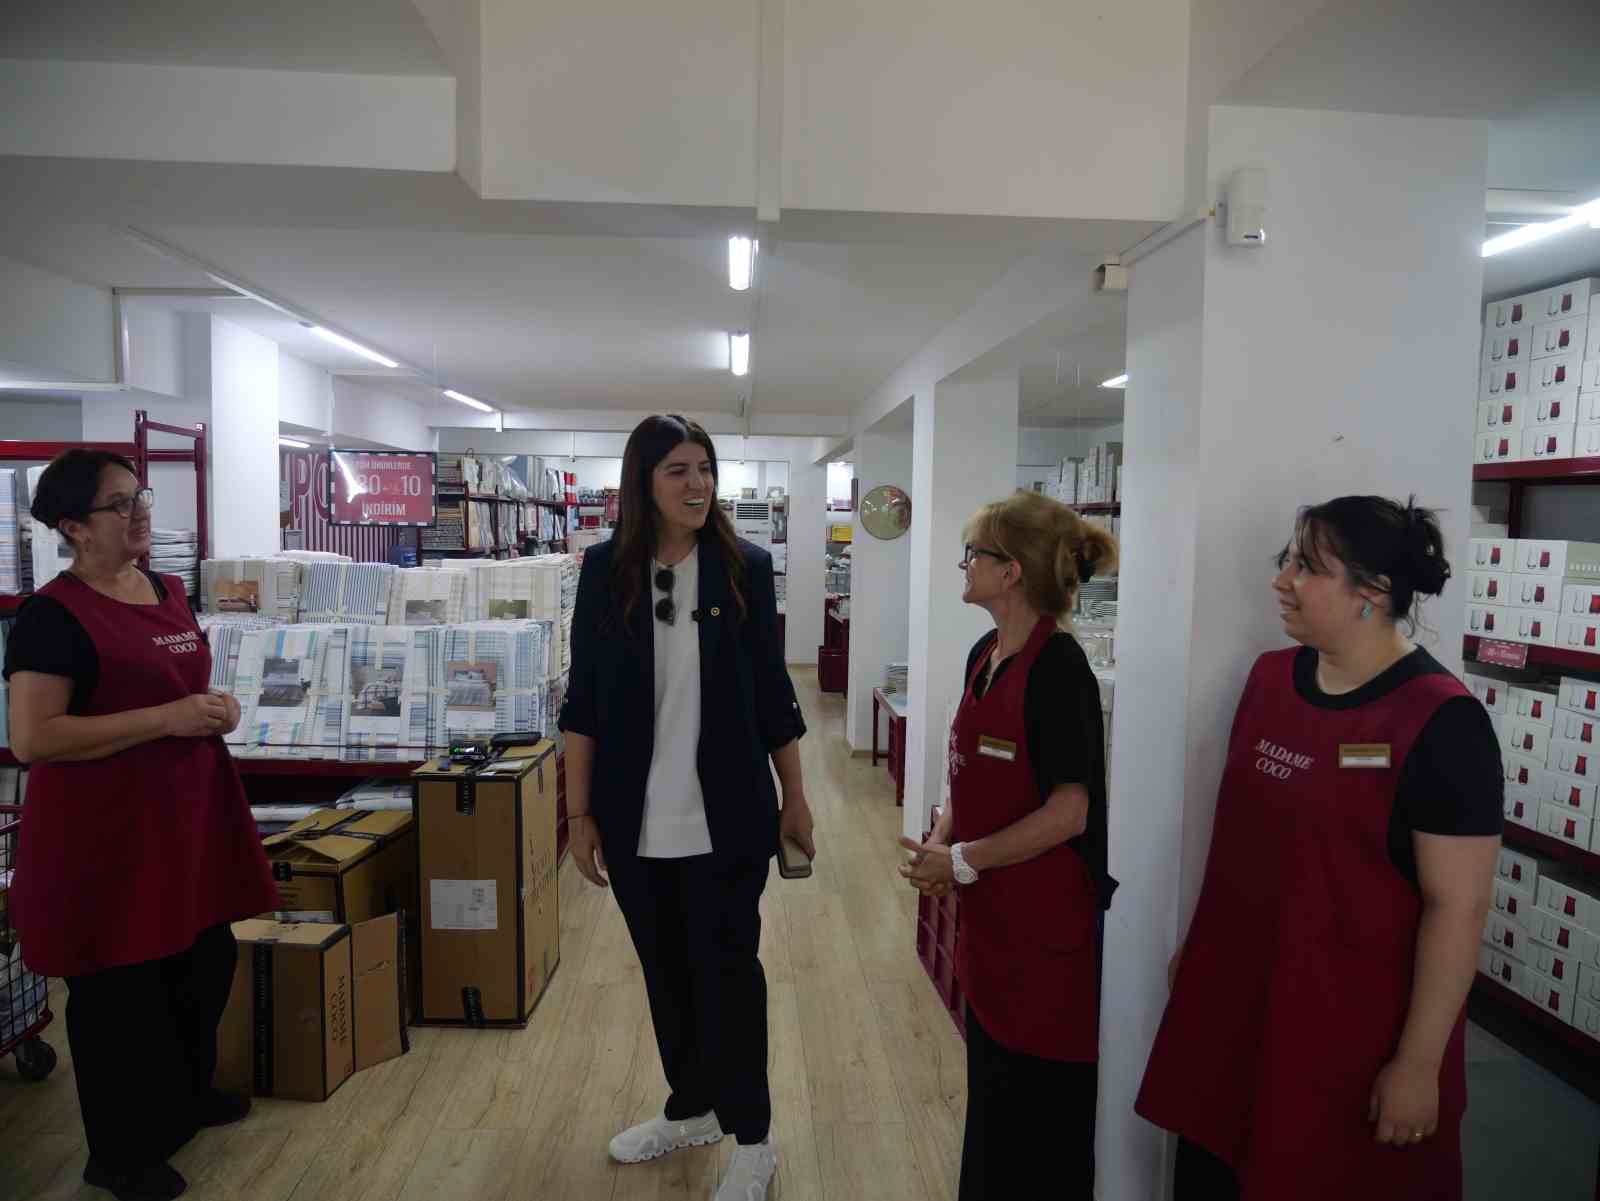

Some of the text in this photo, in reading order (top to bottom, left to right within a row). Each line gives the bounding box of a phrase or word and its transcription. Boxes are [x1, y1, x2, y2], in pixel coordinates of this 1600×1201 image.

[401, 475, 422, 497] 10
[169, 642, 197, 654] COCO
[1255, 739, 1314, 769] MADAME
[1255, 757, 1292, 779] COCO
